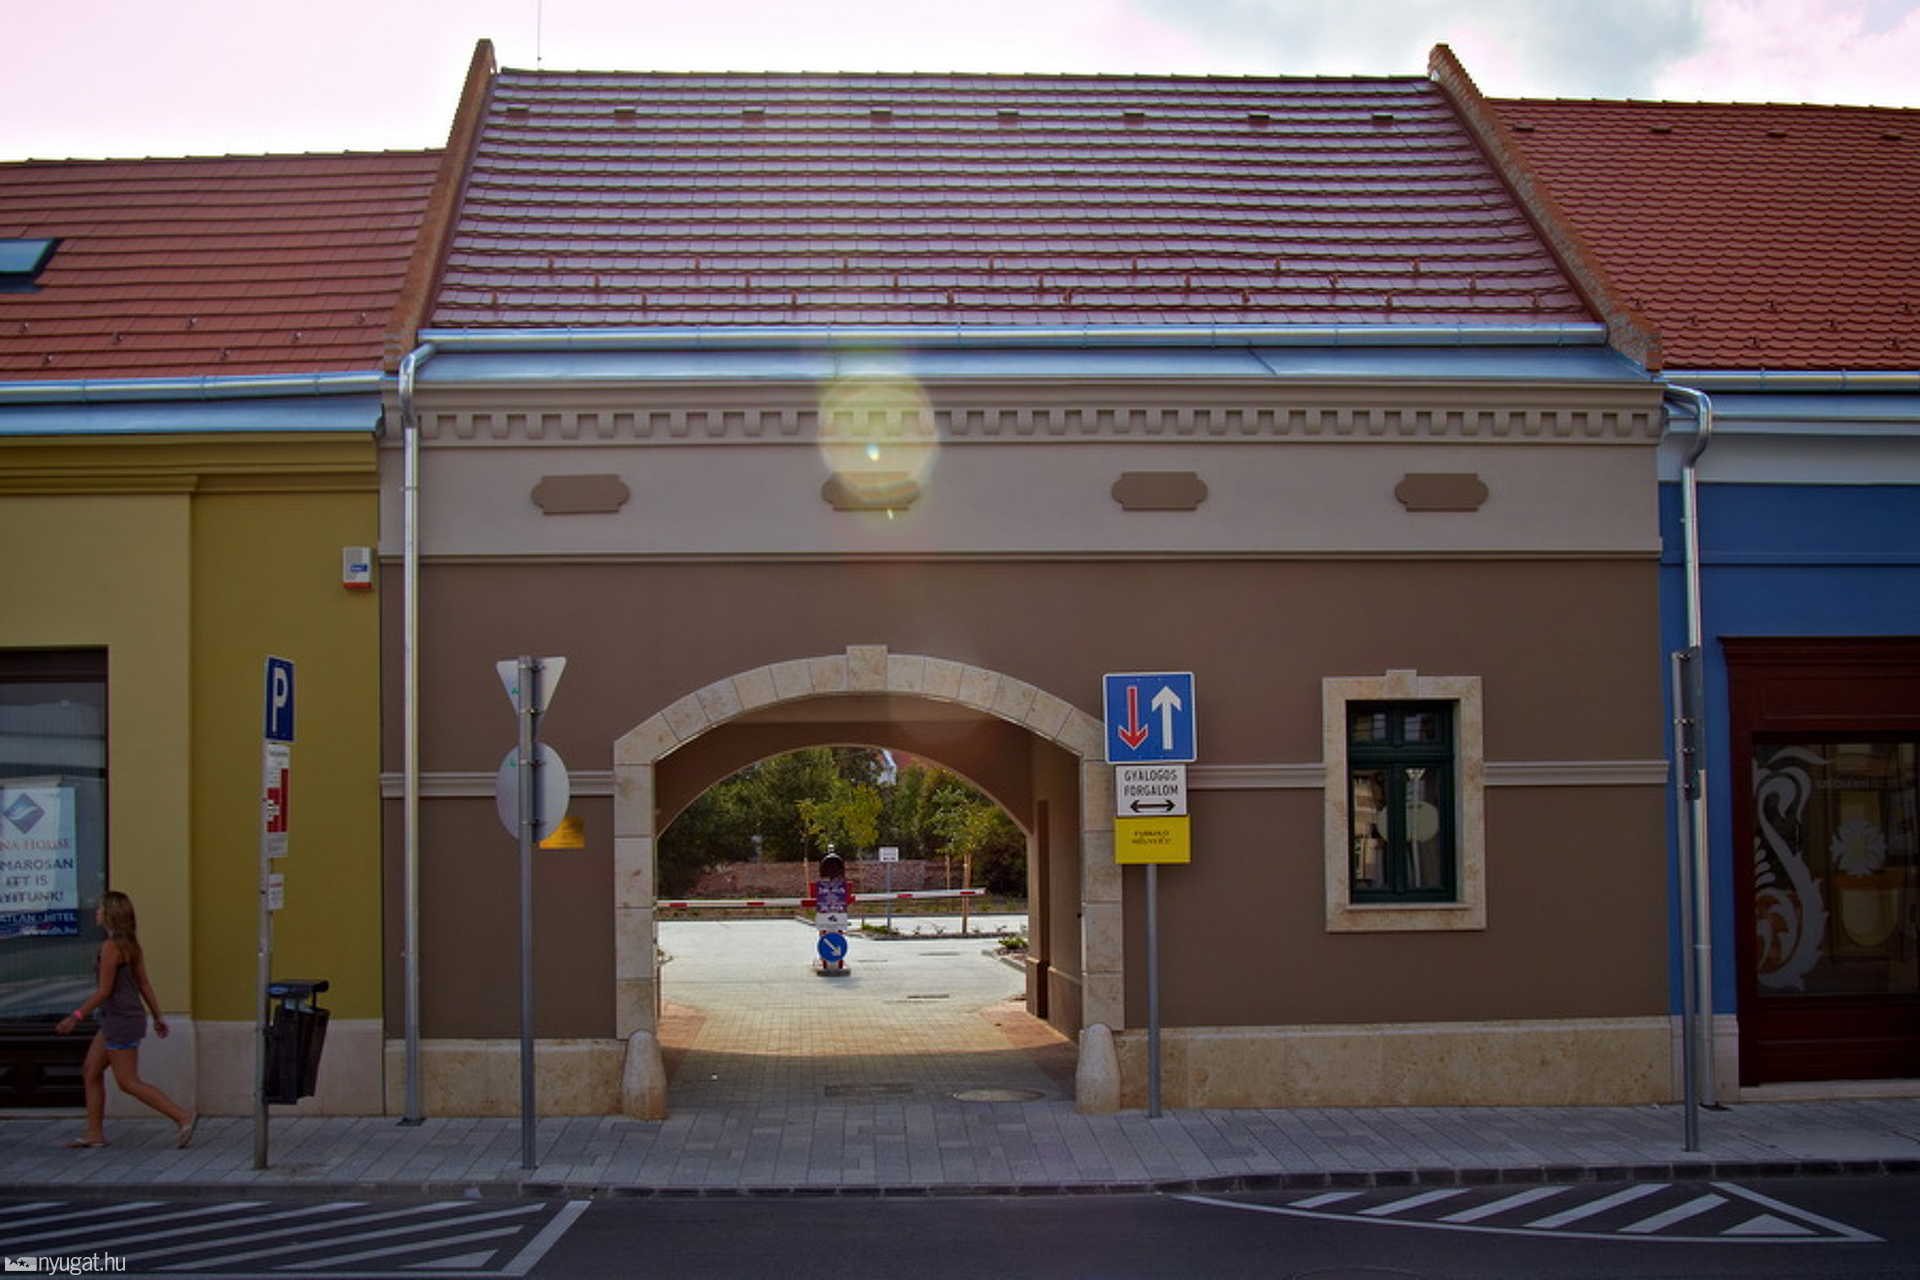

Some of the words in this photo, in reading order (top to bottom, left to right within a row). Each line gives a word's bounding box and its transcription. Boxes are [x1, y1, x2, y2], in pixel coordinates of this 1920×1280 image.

[272, 667, 288, 732] P
[1124, 769, 1178, 782] GYALOGOS
[1124, 785, 1178, 797] FORGALOM
[0, 859, 73, 871] MAROSAN
[35, 874, 49, 887] IS
